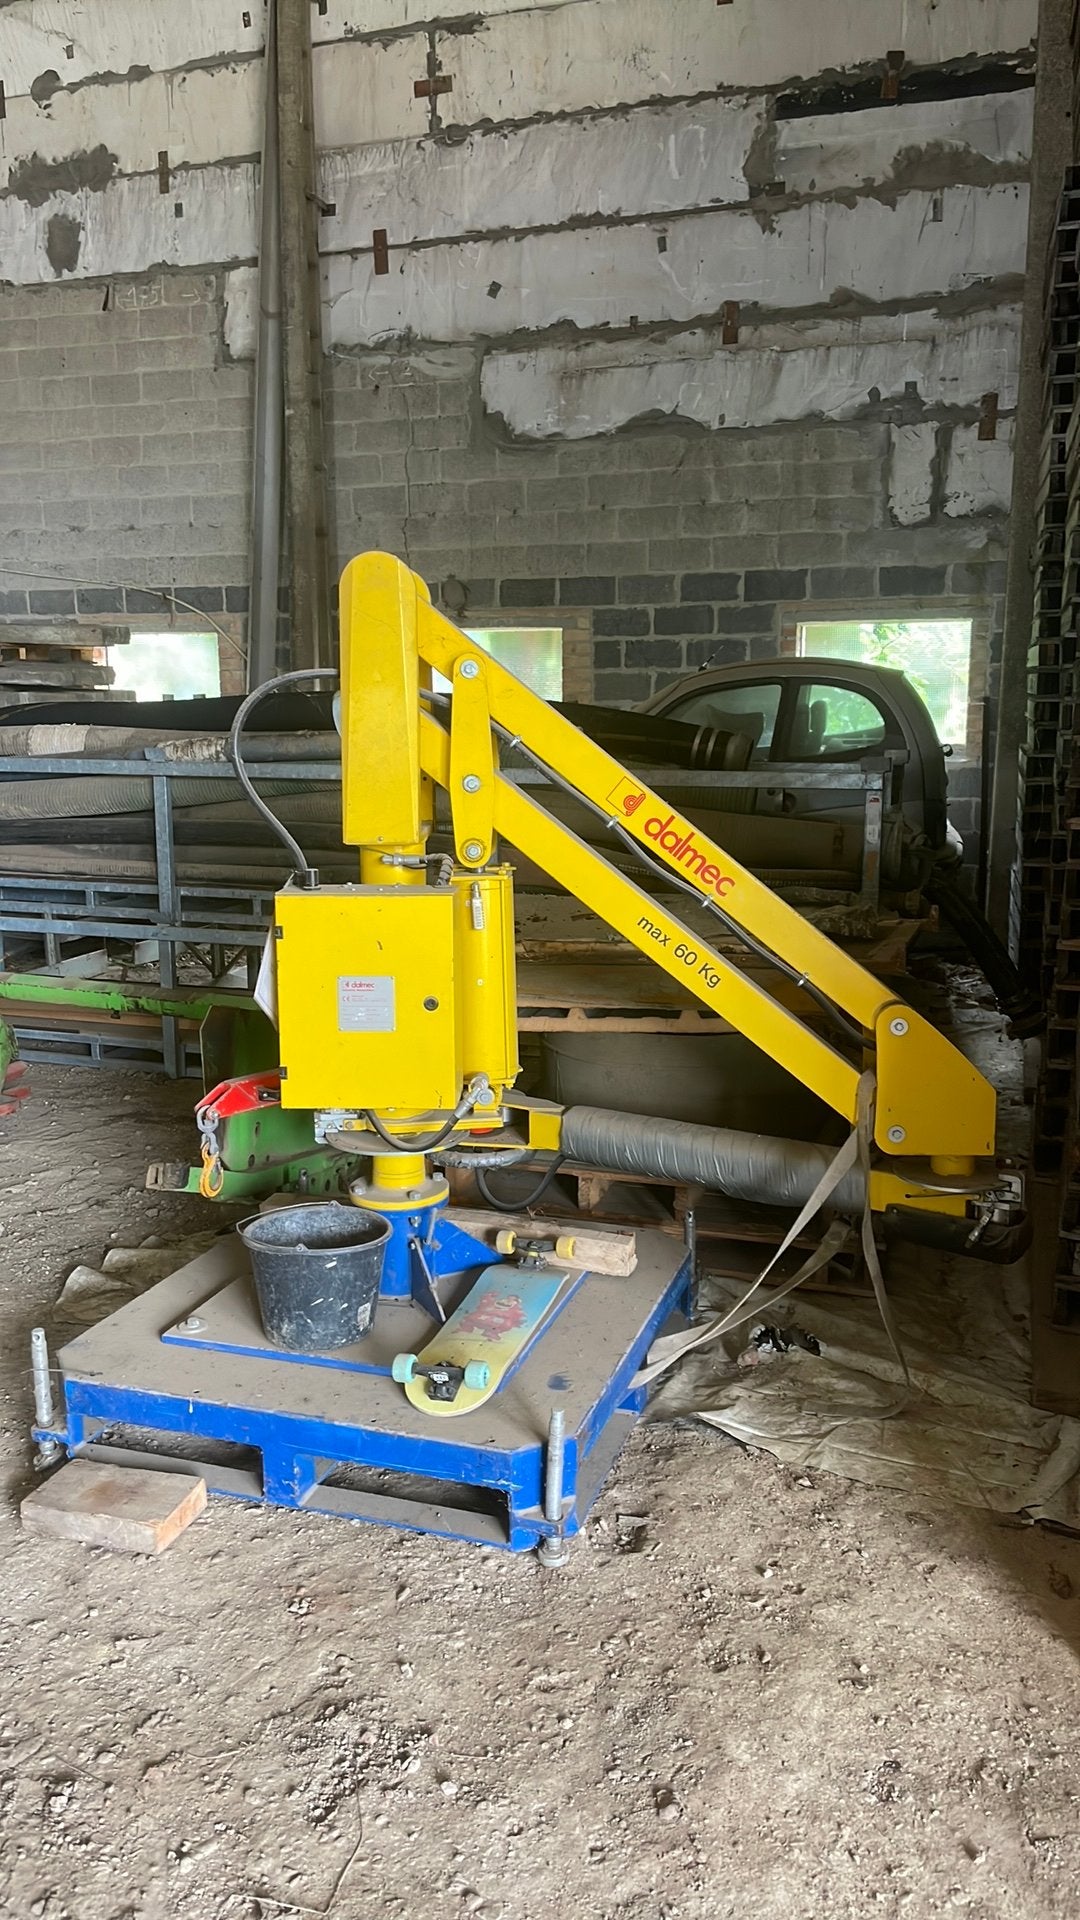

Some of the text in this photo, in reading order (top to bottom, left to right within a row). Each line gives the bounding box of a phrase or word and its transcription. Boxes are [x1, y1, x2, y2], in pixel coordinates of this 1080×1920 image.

[644, 815, 736, 897] dalmec
[637, 916, 721, 989] max 60 Kg
